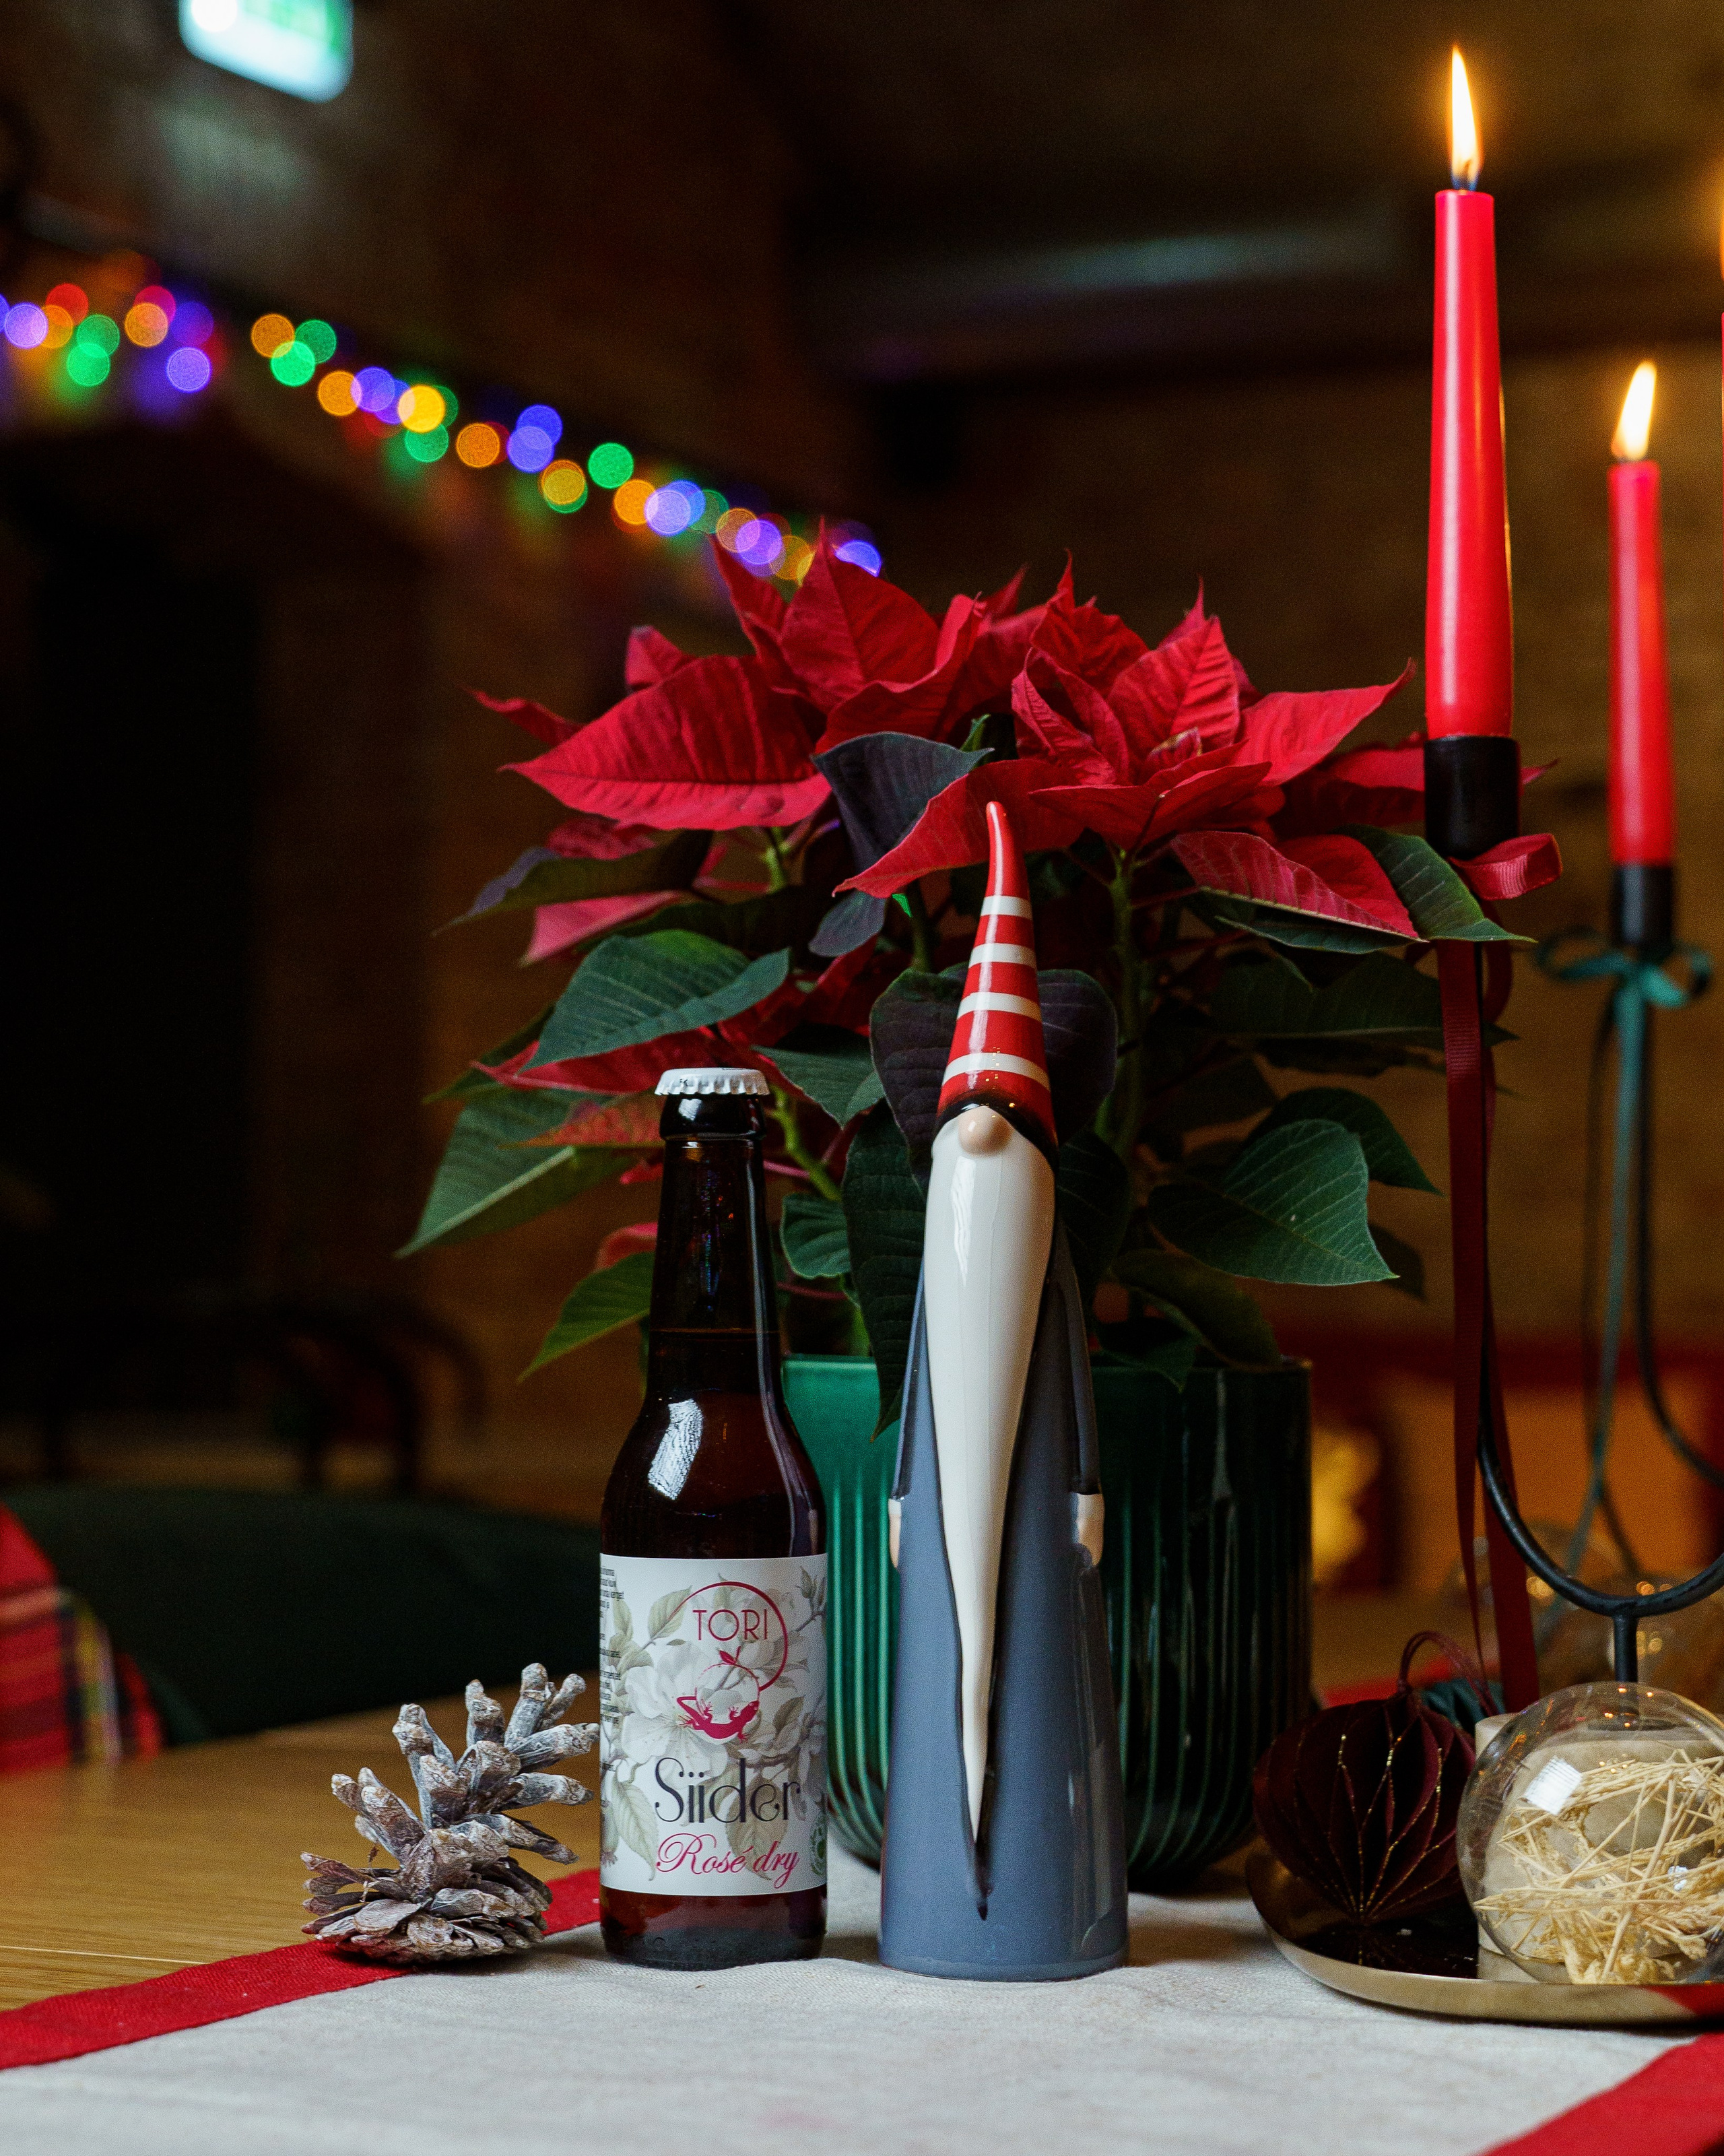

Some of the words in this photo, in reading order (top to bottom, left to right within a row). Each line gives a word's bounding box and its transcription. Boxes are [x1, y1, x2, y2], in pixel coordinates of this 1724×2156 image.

[692, 1608, 768, 1641] TORI
[655, 1757, 801, 1823] Siider
[655, 1833, 754, 1875] Rosé
[752, 1840, 800, 1889] dry
